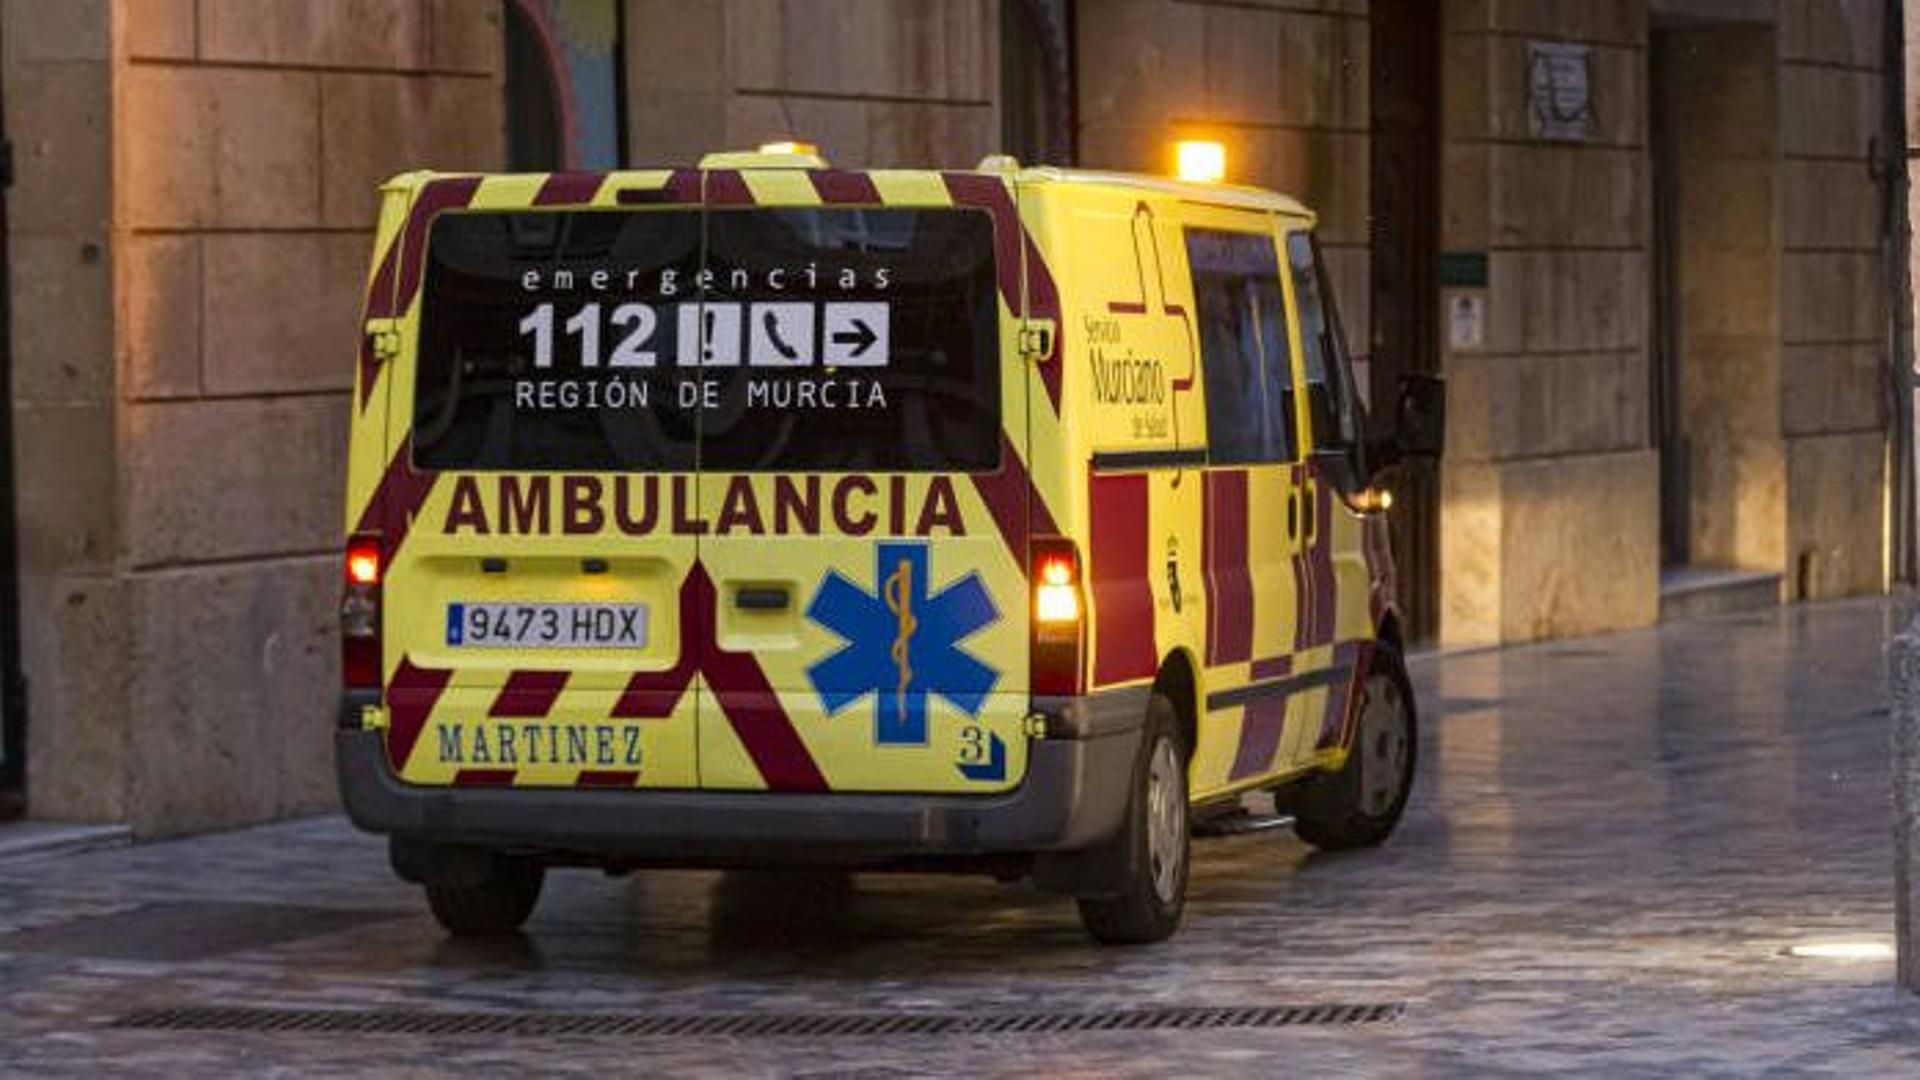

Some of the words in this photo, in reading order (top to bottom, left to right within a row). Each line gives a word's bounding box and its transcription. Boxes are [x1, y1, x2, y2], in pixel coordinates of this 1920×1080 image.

[521, 263, 890, 295] emergencias
[518, 303, 657, 367] 112
[516, 376, 648, 408] REGIÓN
[679, 381, 719, 408] DE
[747, 381, 888, 408] MURCIA
[443, 475, 967, 536] AMBULANCIA
[469, 607, 560, 641] 9473
[571, 607, 639, 642] HDX
[439, 723, 643, 764] MARTINEZ
[960, 726, 983, 762] 3
